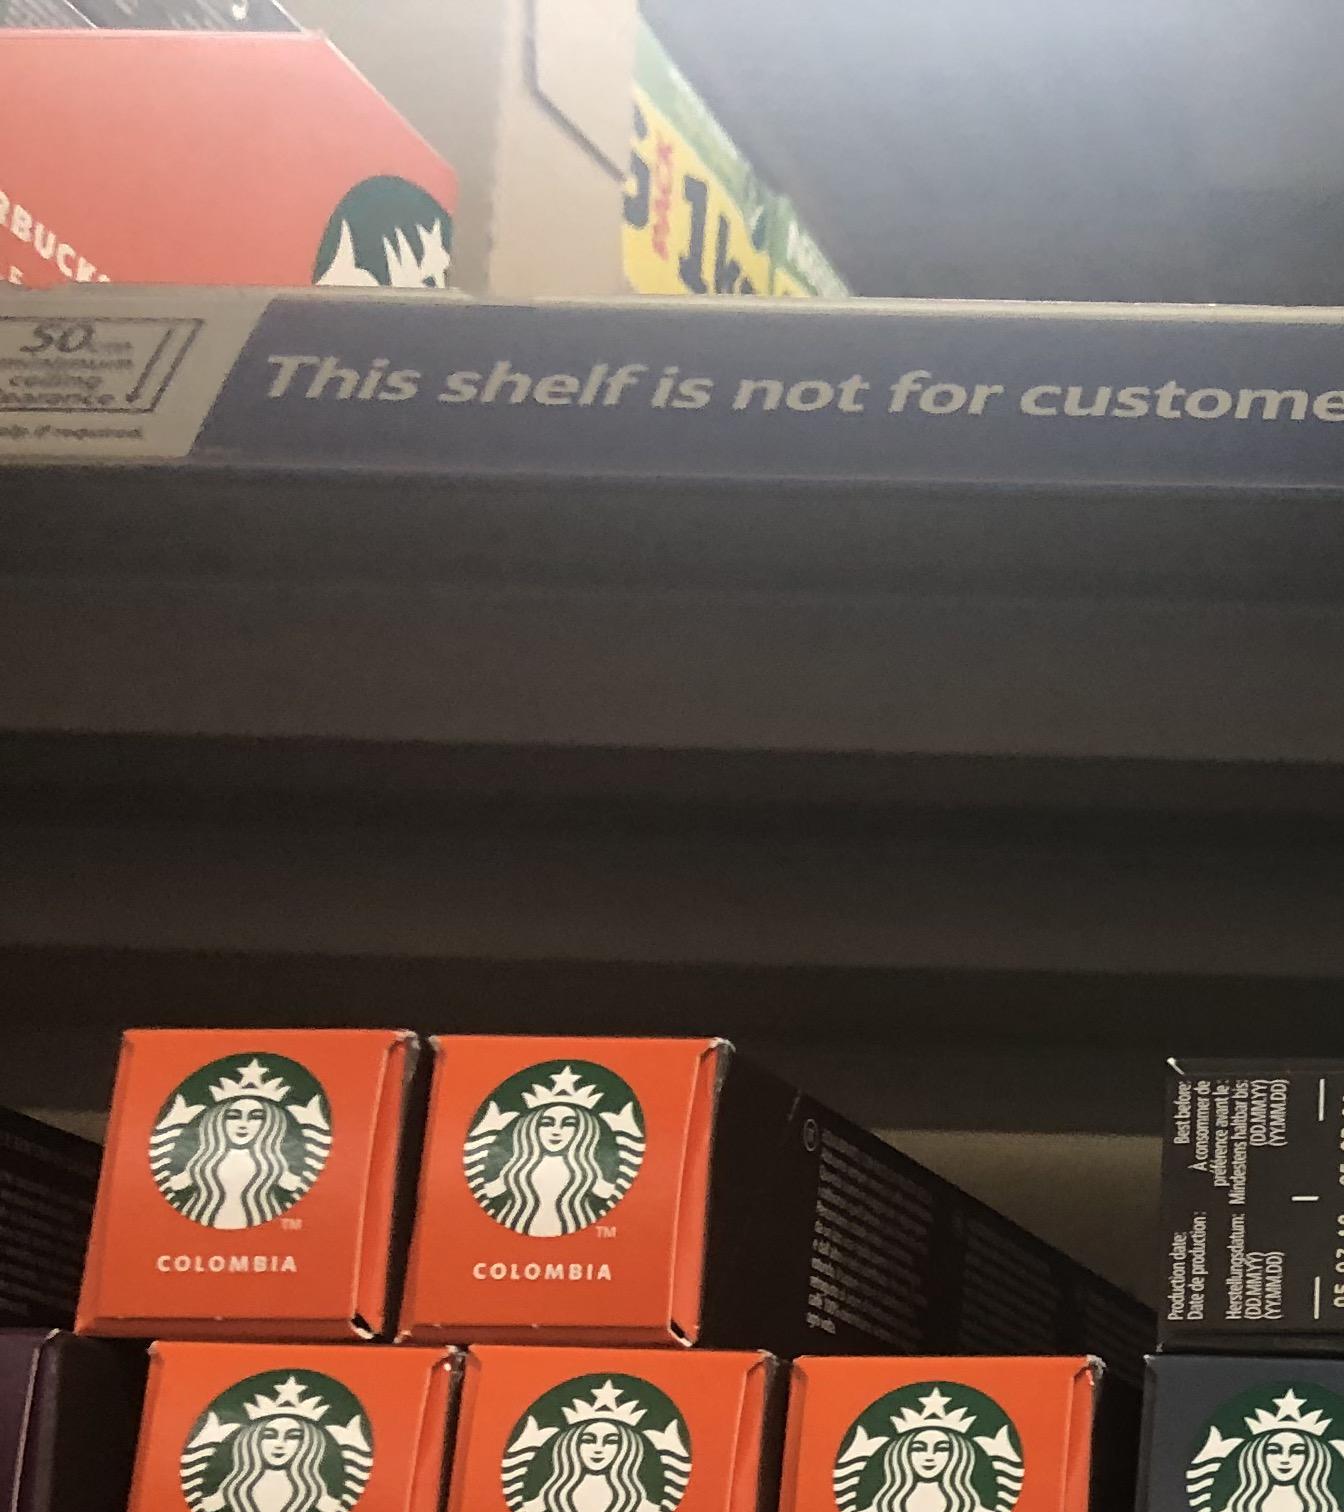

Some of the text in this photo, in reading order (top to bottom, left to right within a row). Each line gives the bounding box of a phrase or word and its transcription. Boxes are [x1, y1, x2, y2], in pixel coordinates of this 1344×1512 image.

[268, 355, 421, 400] This
[439, 361, 649, 405] shelf
[652, 366, 713, 409] is
[733, 375, 869, 411] not
[888, 370, 1003, 414] for
[1195, 1081, 1210, 1095] de
[1174, 1081, 1192, 1144] Best before:
[1195, 1097, 1210, 1160] consommer
[1214, 1097, 1229, 1127] avant
[1229, 1080, 1248, 1204] Mindestens haltbar bis:
[157, 1255, 296, 1272] COLOMBIA
[473, 1263, 611, 1280] COLOMBIA
[1168, 1232, 1187, 1320] Production date:
[1190, 1277, 1205, 1291] de
[1225, 1214, 1248, 1320] Herstellungsdatum:
[1189, 1294, 1205, 1320] Date
